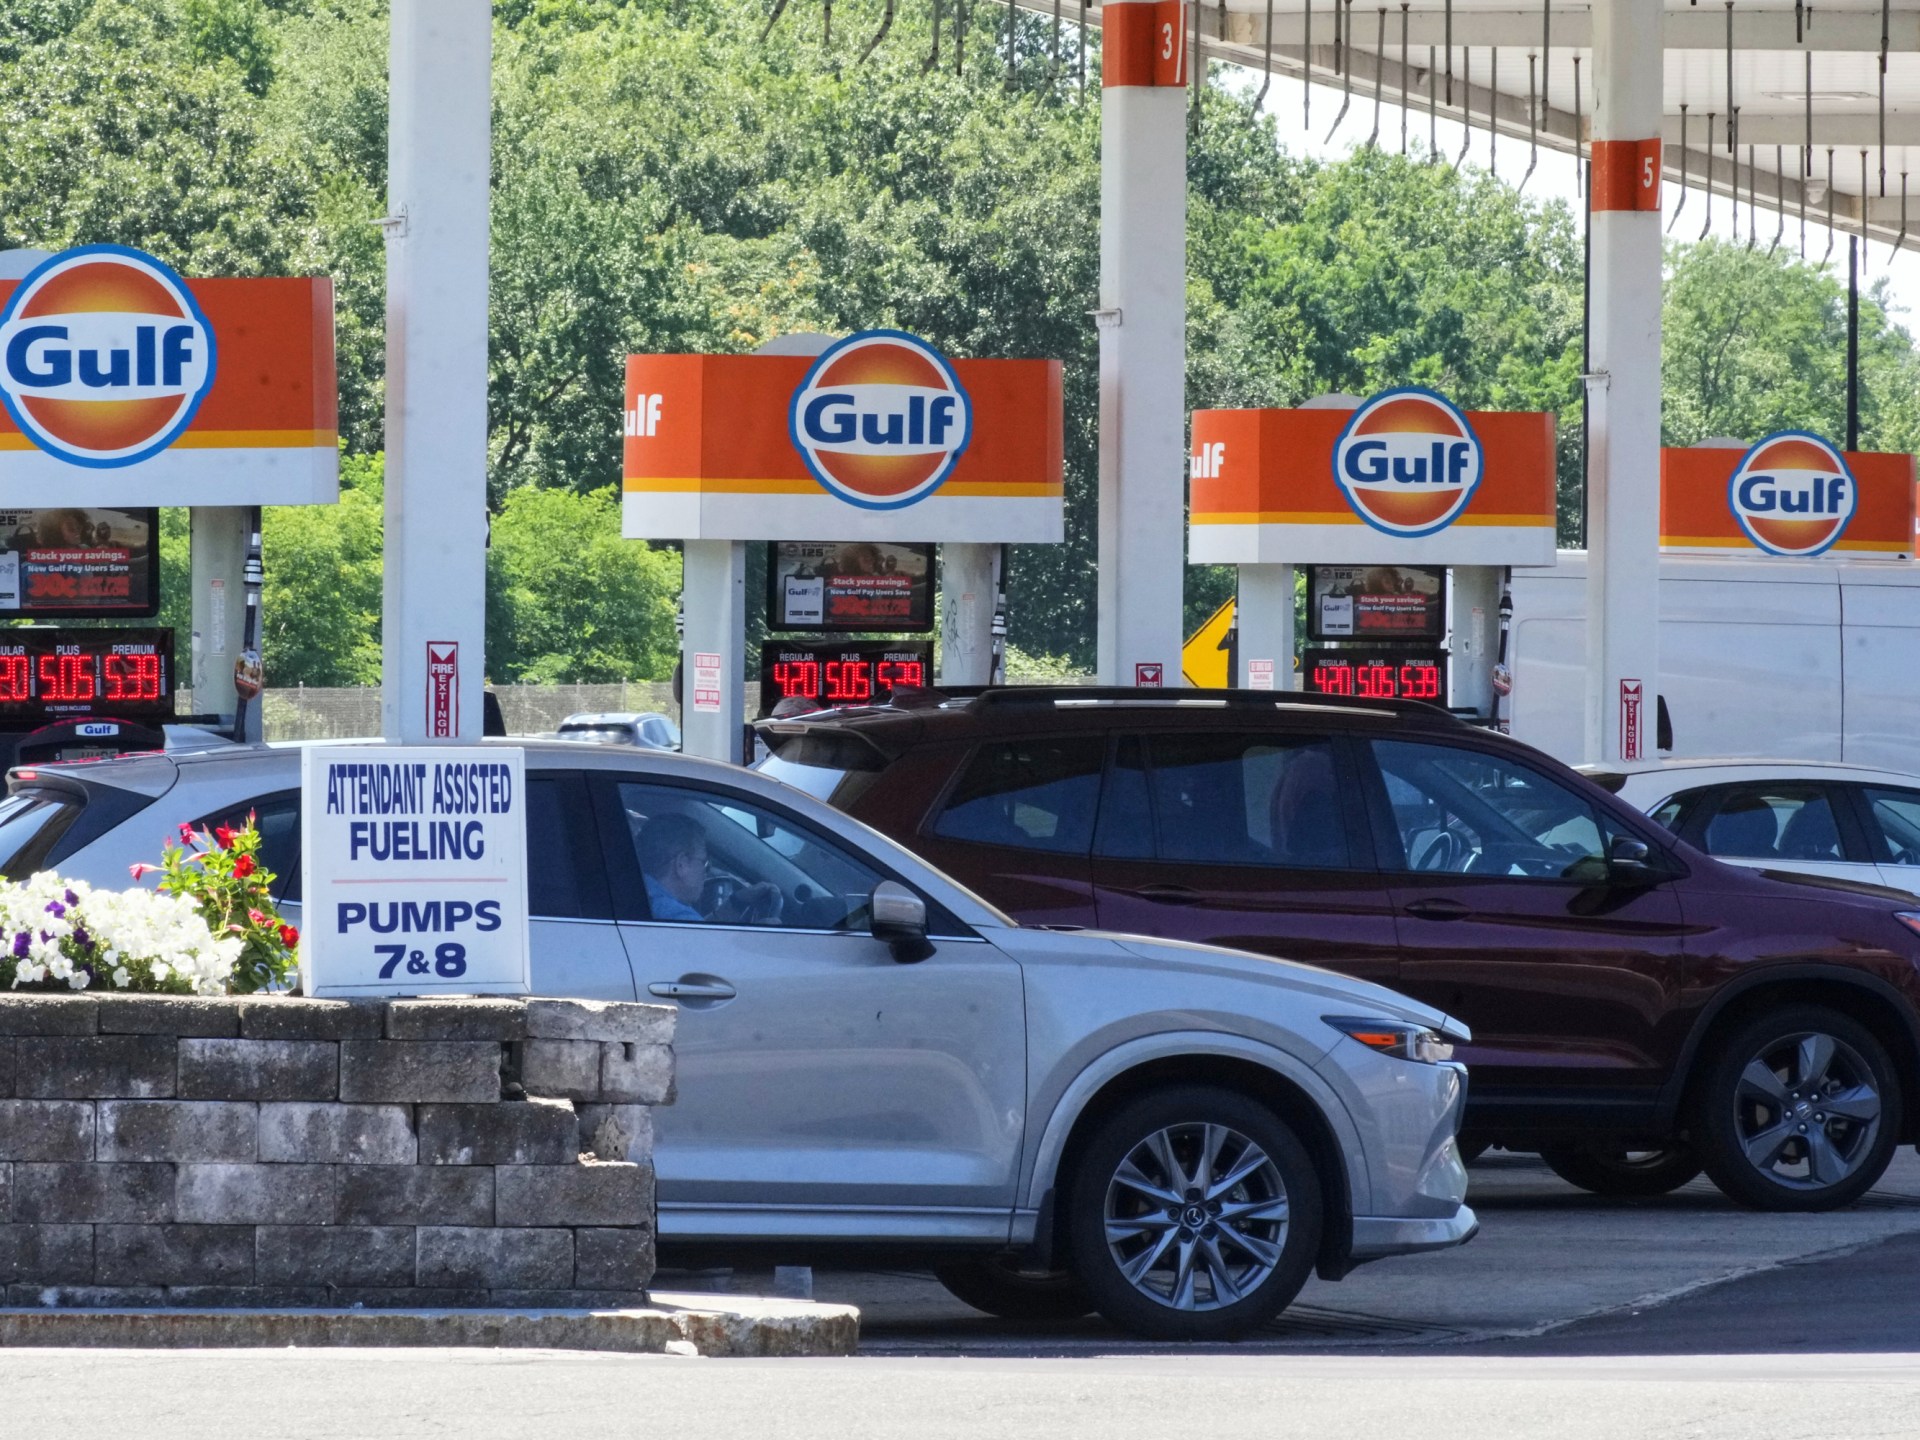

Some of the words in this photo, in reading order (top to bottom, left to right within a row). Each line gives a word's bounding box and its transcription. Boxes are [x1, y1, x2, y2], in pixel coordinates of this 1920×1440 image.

[1162, 22, 1172, 60] 3
[1643, 157, 1653, 188] 5
[6, 325, 194, 387] Gulf
[623, 394, 662, 437] ulf
[803, 393, 955, 445] Gulf
[1190, 443, 1225, 479] ulf
[1344, 441, 1470, 483] Gulf
[1738, 475, 1845, 513] Gulf
[30, 551, 57, 560] Stack
[60, 552, 82, 561] your
[85, 551, 126, 561] savings.
[48, 564, 66, 572] Gulf
[67, 564, 83, 573] Pay
[85, 564, 107, 572] Users
[109, 564, 129, 572] Save
[862, 589, 874, 597] Pay
[876, 578, 908, 586] savings.
[0, 646, 25, 655] ULAR
[56, 645, 80, 655] PLUS
[112, 645, 155, 655] PREMIUM
[779, 653, 814, 661] REGULAR
[841, 653, 860, 661] PLUS
[884, 653, 918, 661] PREMIUM
[432, 663, 454, 674] FIRE
[438, 674, 447, 737] EXTINGU
[1624, 693, 1640, 701] FIRE
[84, 725, 112, 735] Gulf
[327, 763, 426, 815] ATTENDANT
[432, 763, 512, 814] ASSISTED
[350, 820, 485, 861] FUELING
[337, 900, 502, 934] PUMPS
[374, 942, 467, 979] 7&8
